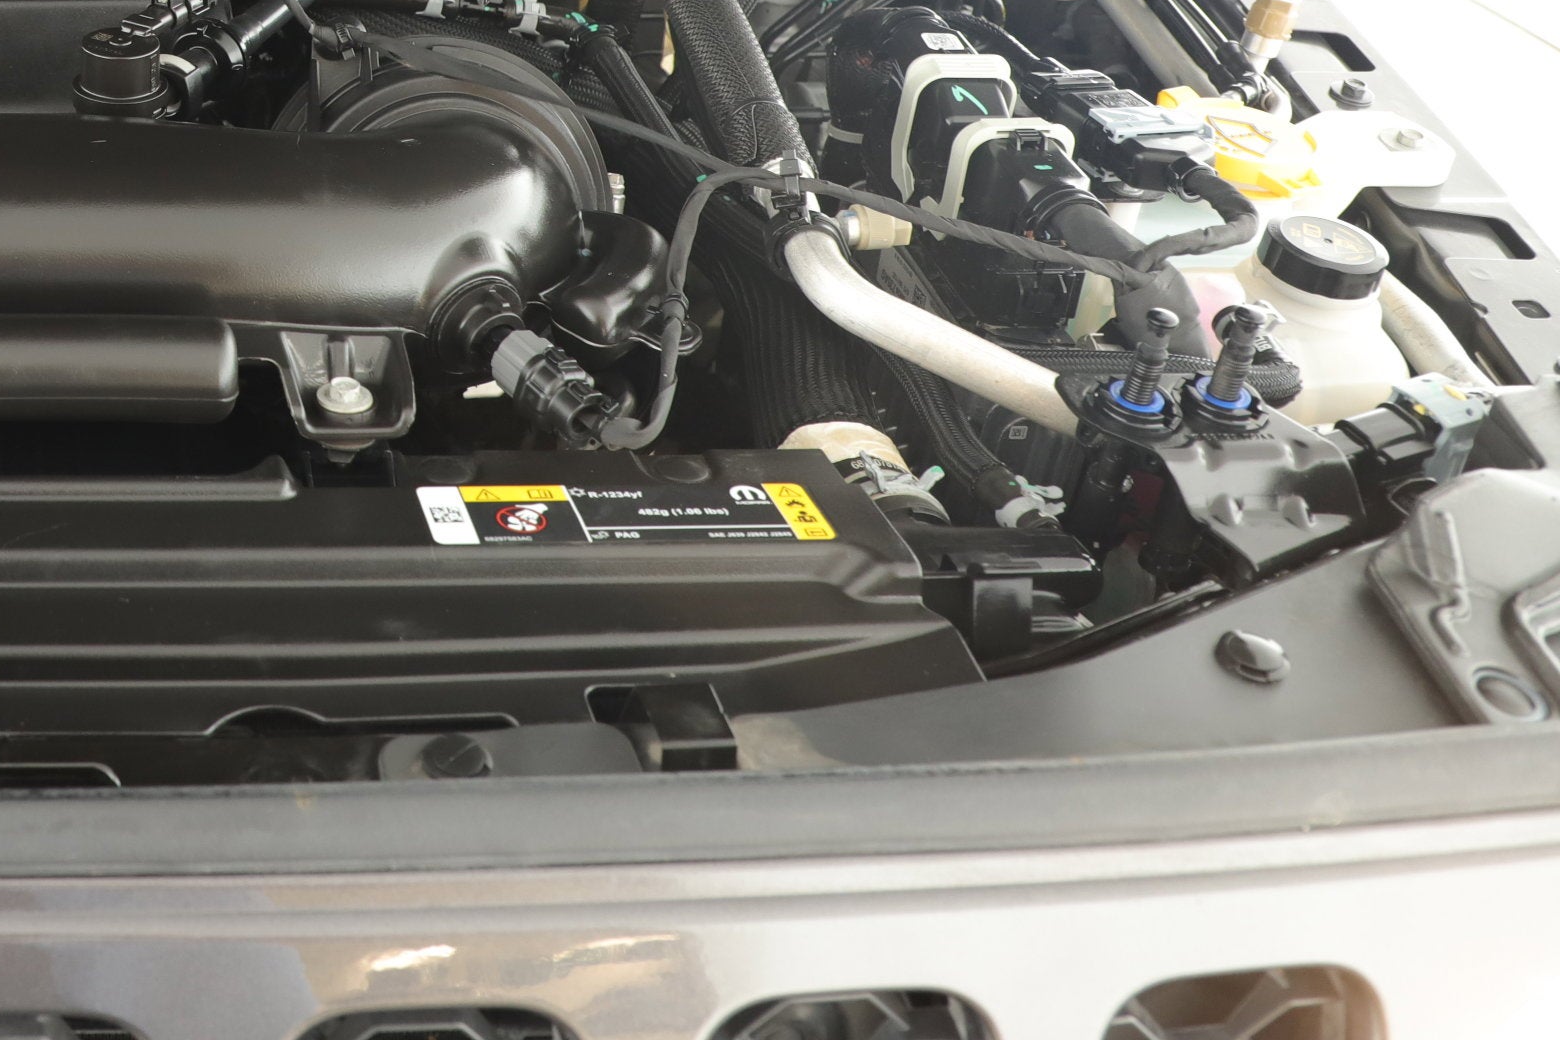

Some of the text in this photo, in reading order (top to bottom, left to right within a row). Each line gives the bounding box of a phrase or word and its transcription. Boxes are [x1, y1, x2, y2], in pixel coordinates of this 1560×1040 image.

[587, 490, 643, 499] R-1234yf
[704, 507, 729, 516] lbs)
[614, 531, 640, 539] PAG
